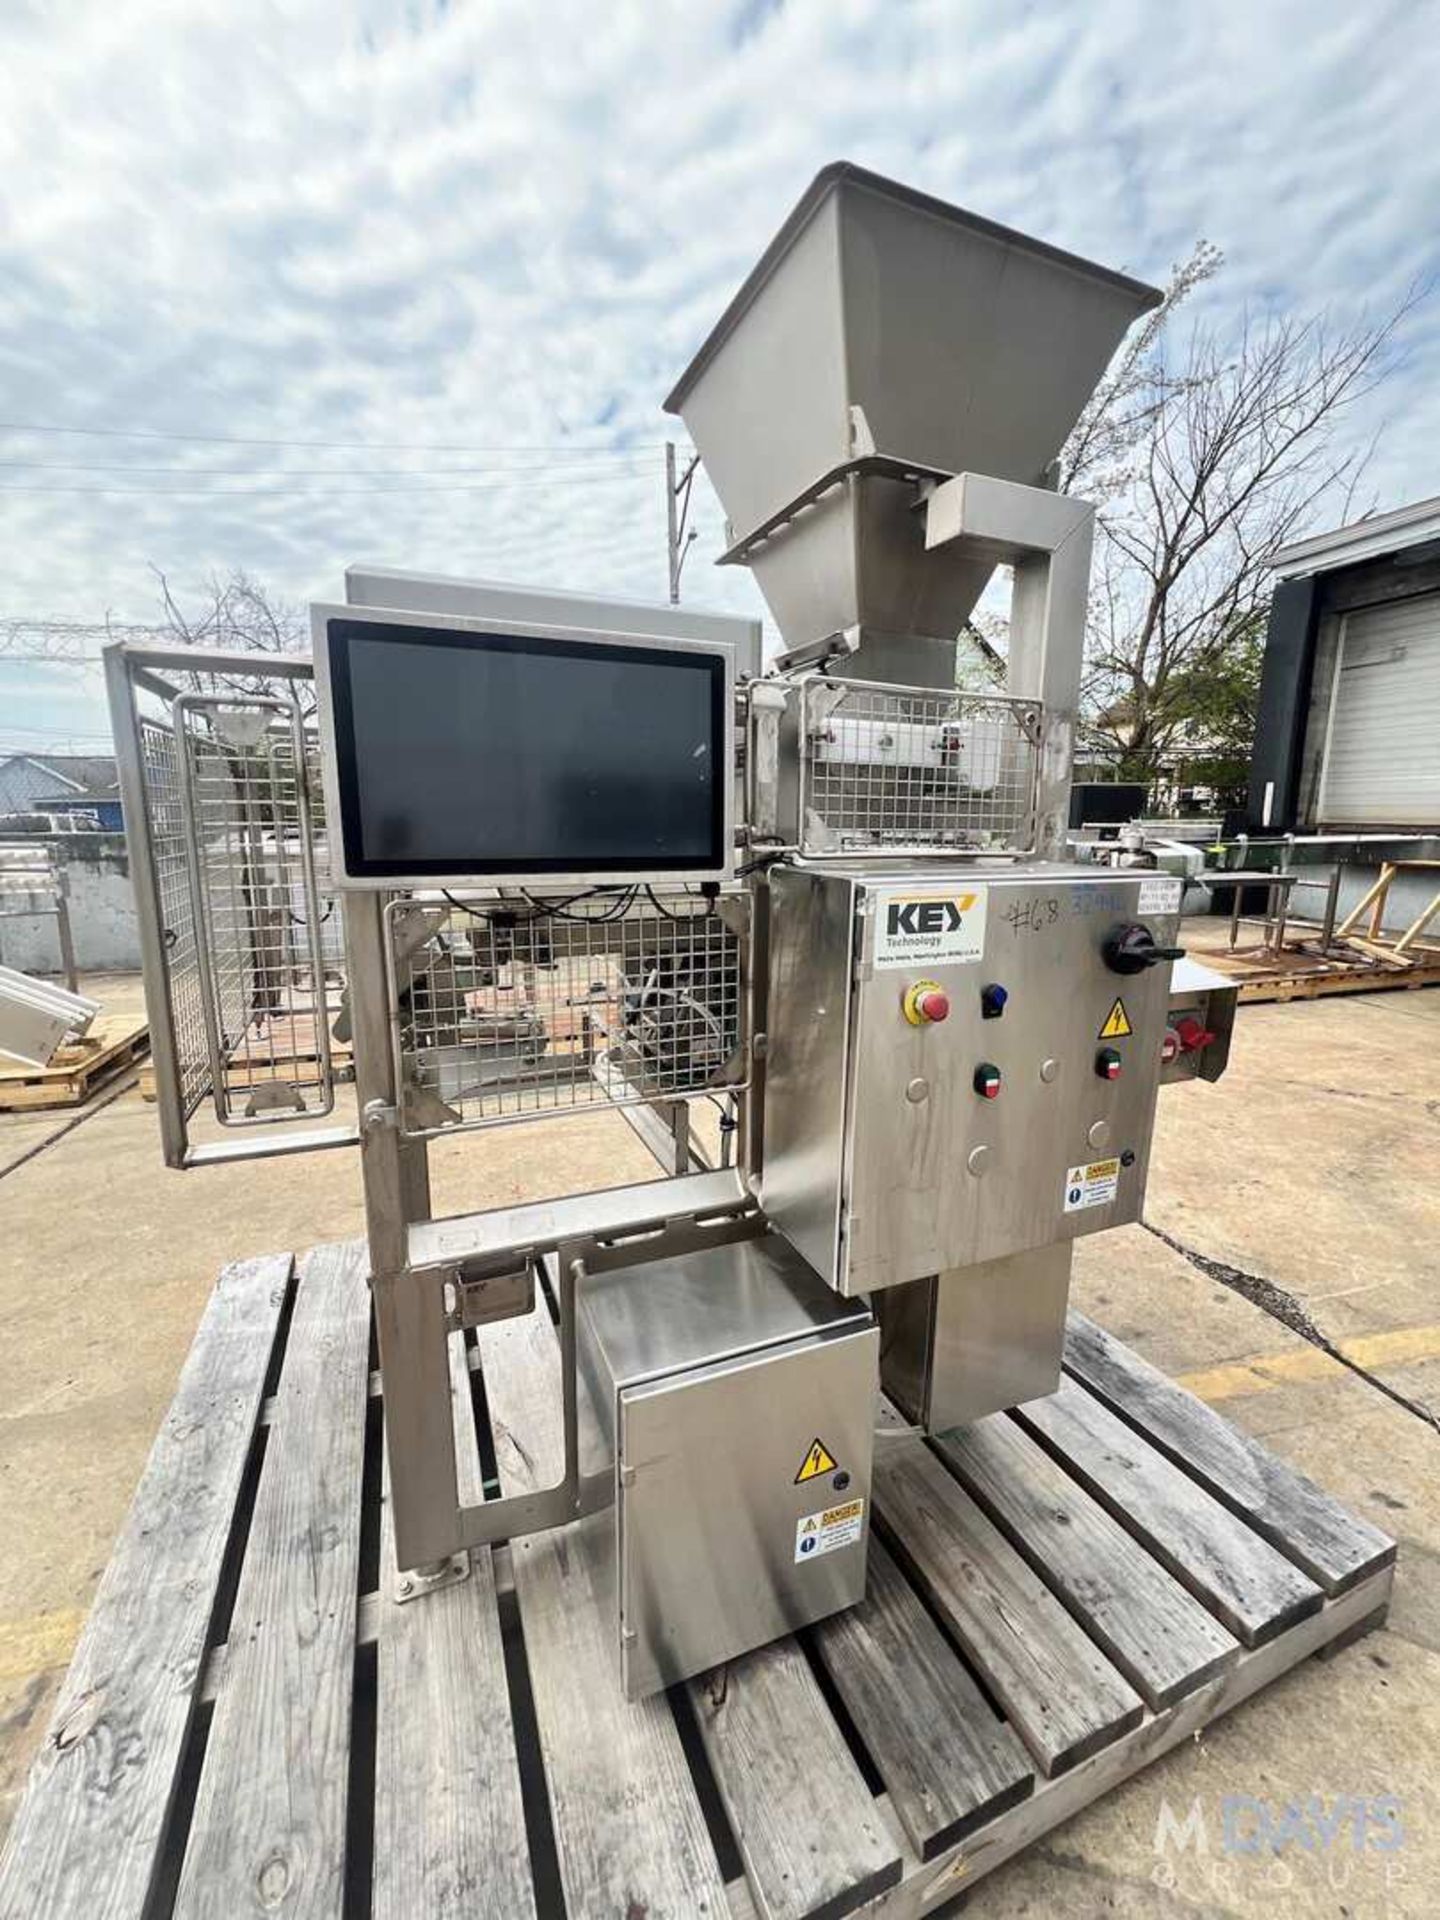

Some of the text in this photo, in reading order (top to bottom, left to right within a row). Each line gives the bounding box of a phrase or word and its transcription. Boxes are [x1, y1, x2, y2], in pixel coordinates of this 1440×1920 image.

[887, 896, 975, 935] KEY
[886, 935, 942, 948] Technology
[822, 1503, 859, 1523] DANGER
